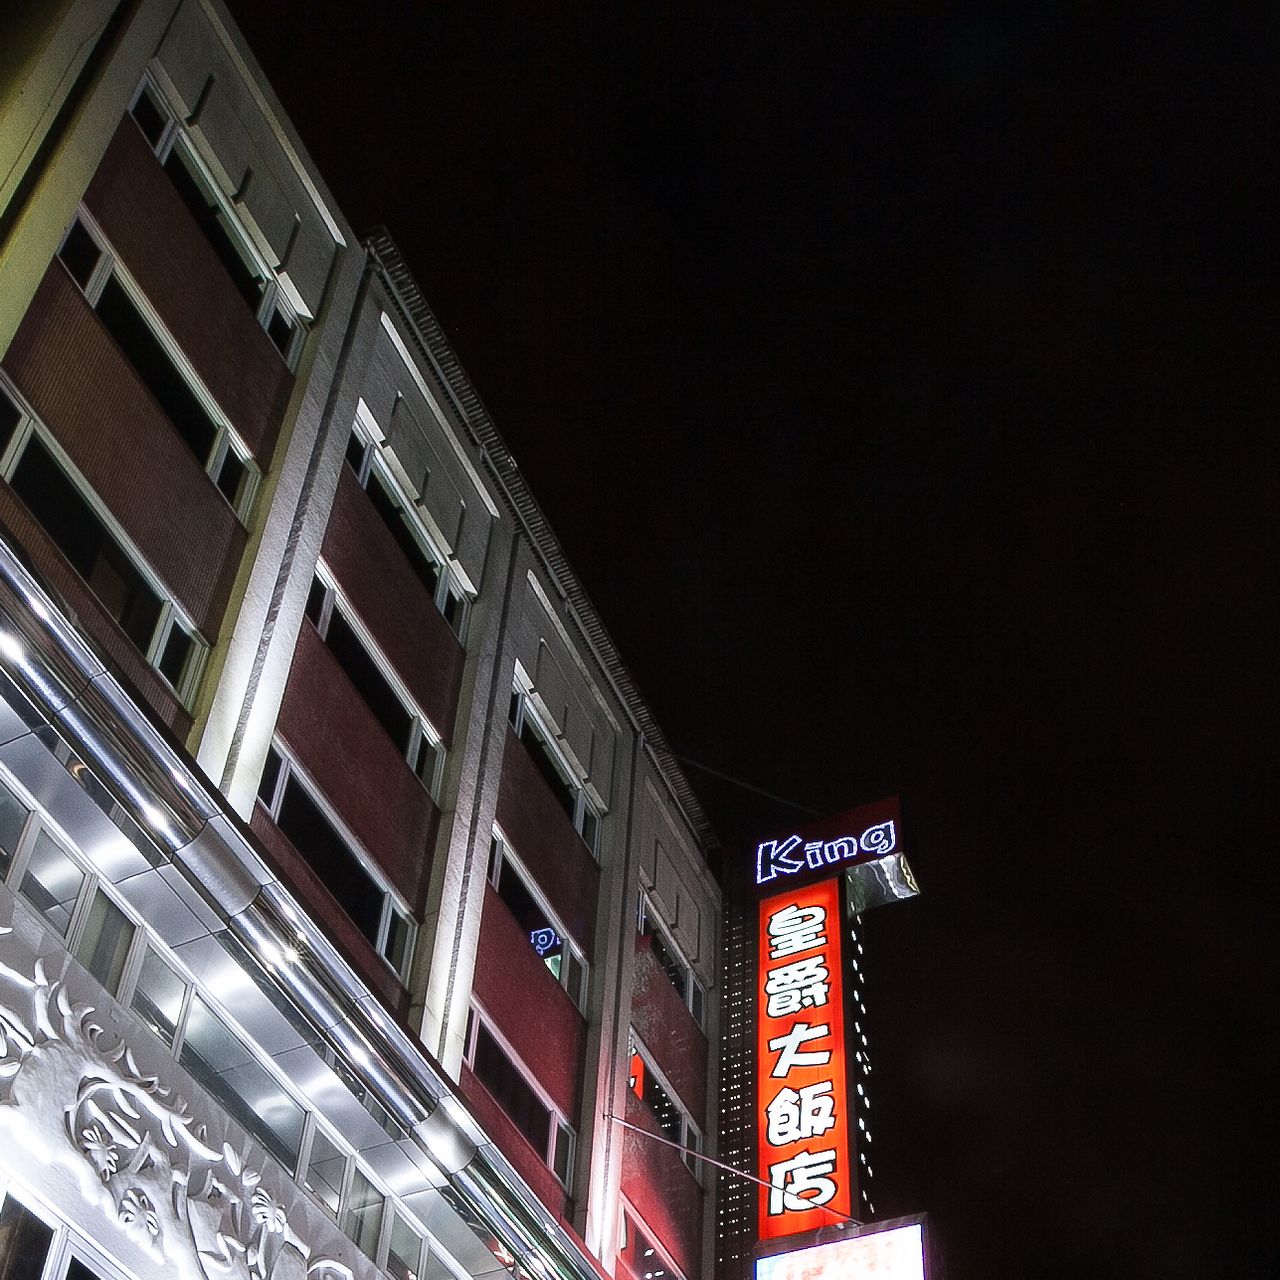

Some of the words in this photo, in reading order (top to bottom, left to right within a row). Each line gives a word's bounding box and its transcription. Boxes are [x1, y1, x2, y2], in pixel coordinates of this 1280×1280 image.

[756, 819, 897, 883] King
[767, 903, 838, 1216] 皇爵大飯店
